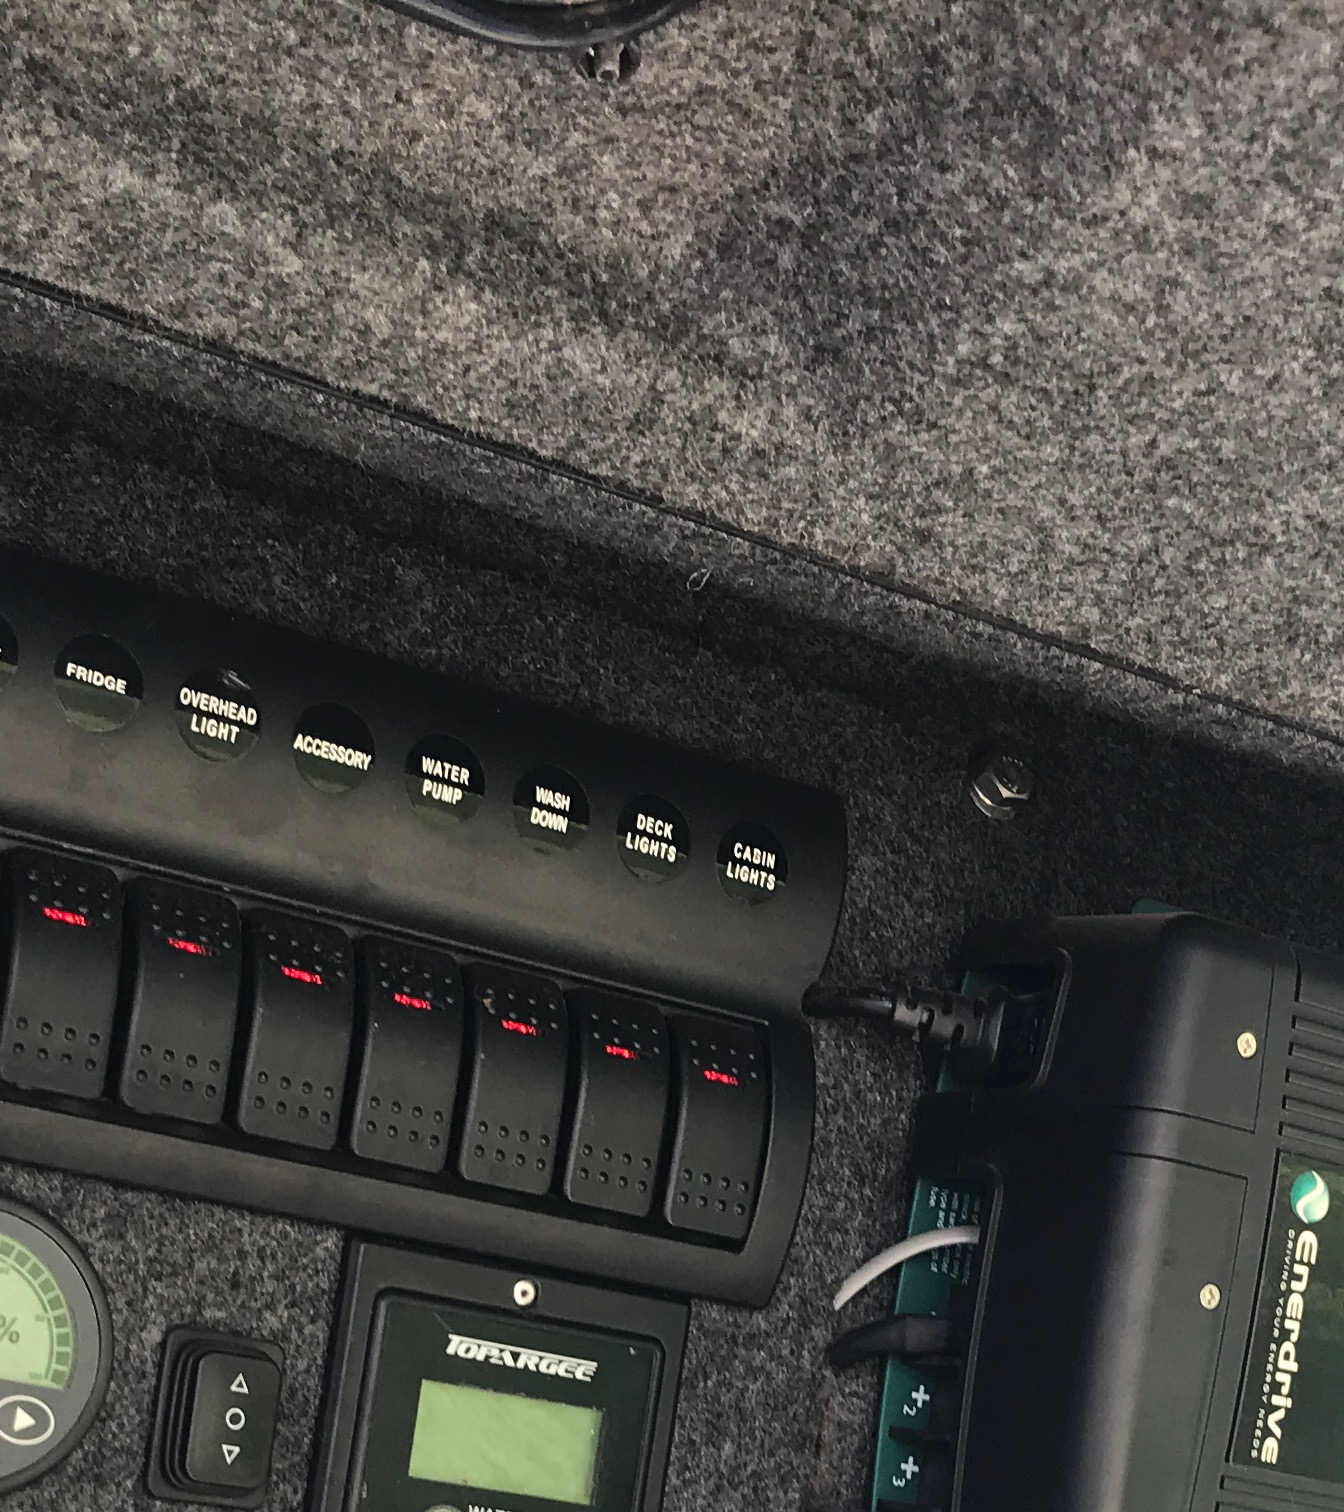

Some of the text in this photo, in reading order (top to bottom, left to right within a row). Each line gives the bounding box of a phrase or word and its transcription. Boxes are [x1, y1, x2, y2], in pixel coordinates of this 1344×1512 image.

[66, 661, 127, 695] FRIDGE
[179, 686, 258, 727] OVERHEAD
[190, 712, 240, 744] LIGHT
[293, 733, 372, 771] ACCESSORY
[421, 755, 471, 787] WATER
[422, 780, 463, 806] PUMP
[535, 785, 571, 812] WASH
[530, 806, 568, 834] DOWN
[636, 812, 674, 841] DECK
[625, 831, 678, 864] LIGHTS
[733, 841, 776, 871] CABIN
[726, 860, 777, 893] LIGHTS
[1271, 1297, 1286, 1339] YOUR
[445, 1333, 599, 1383] TOPARGEE
[1260, 1229, 1319, 1466] Enerdrive
[1261, 1342, 1277, 1405] ENERGY
[1250, 1408, 1266, 1460] NEEDS
